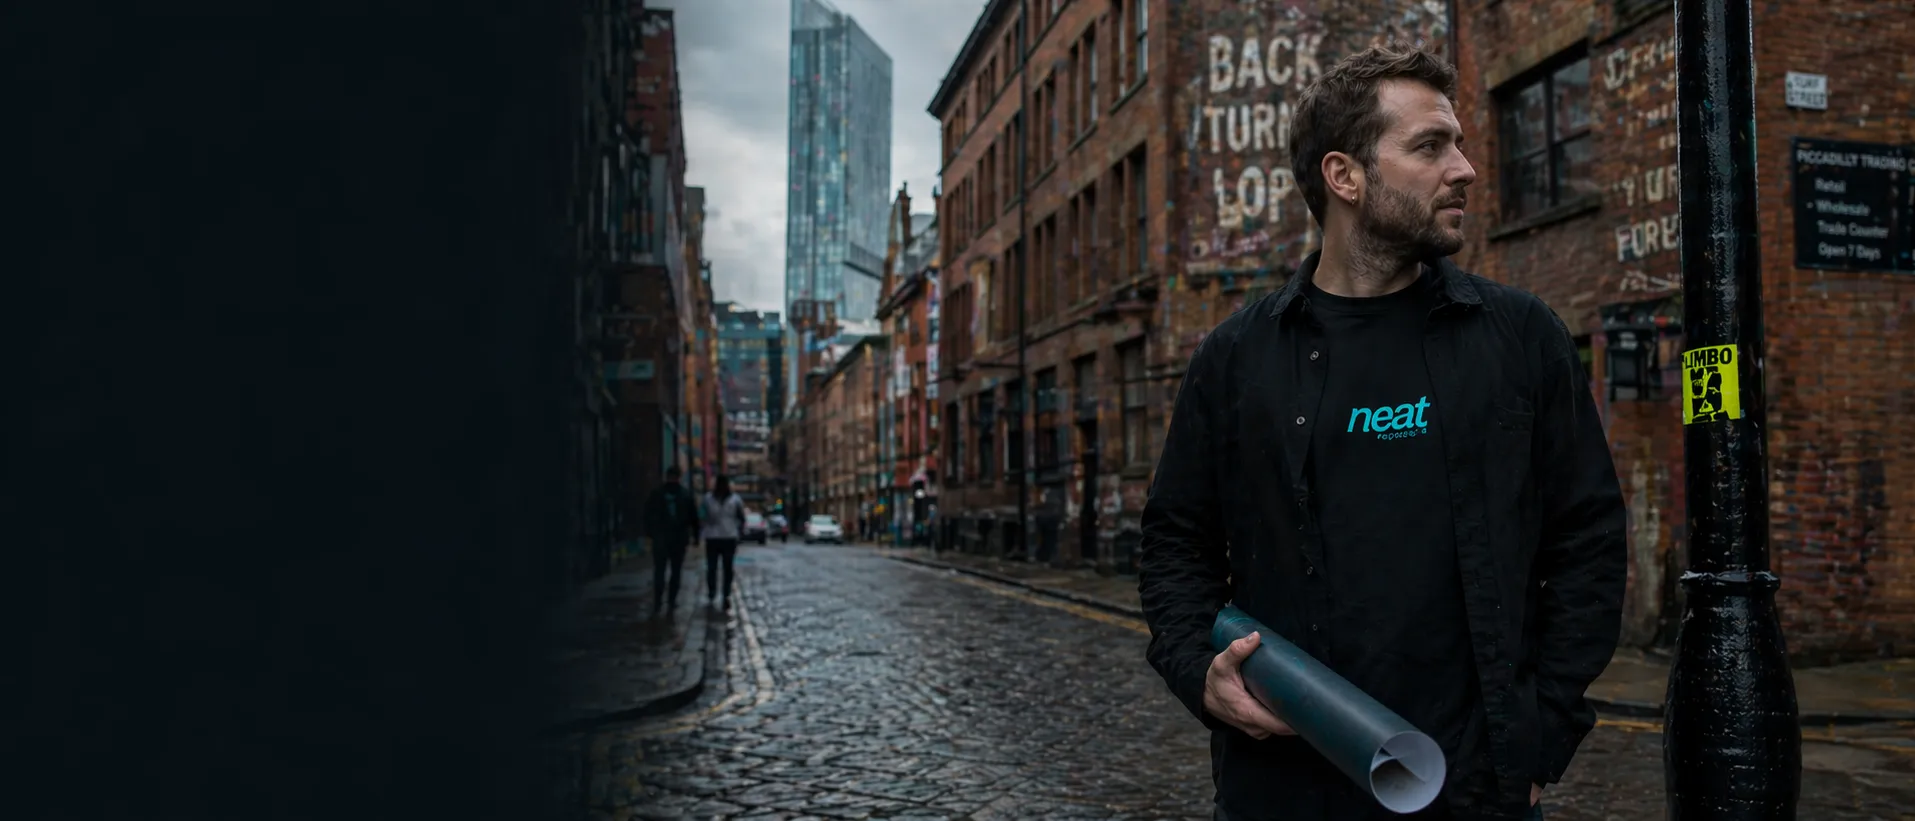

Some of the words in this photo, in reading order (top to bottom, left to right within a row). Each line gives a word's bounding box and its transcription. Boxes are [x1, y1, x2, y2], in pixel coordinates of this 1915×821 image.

[1208, 34, 1322, 92] BACK
[1797, 149, 1858, 167] PICCADILLY
[1861, 153, 1906, 171] TRADING
[1815, 178, 1846, 193] Retail
[1816, 200, 1870, 216] Wholesale
[1817, 220, 1847, 236] Trade
[1849, 222, 1889, 238] Counter
[1818, 242, 1846, 258] Open
[1848, 244, 1855, 256] 7
[1856, 244, 1881, 261] Days
[1685, 347, 1733, 368] LIMBO
[1347, 396, 1430, 432] neat
